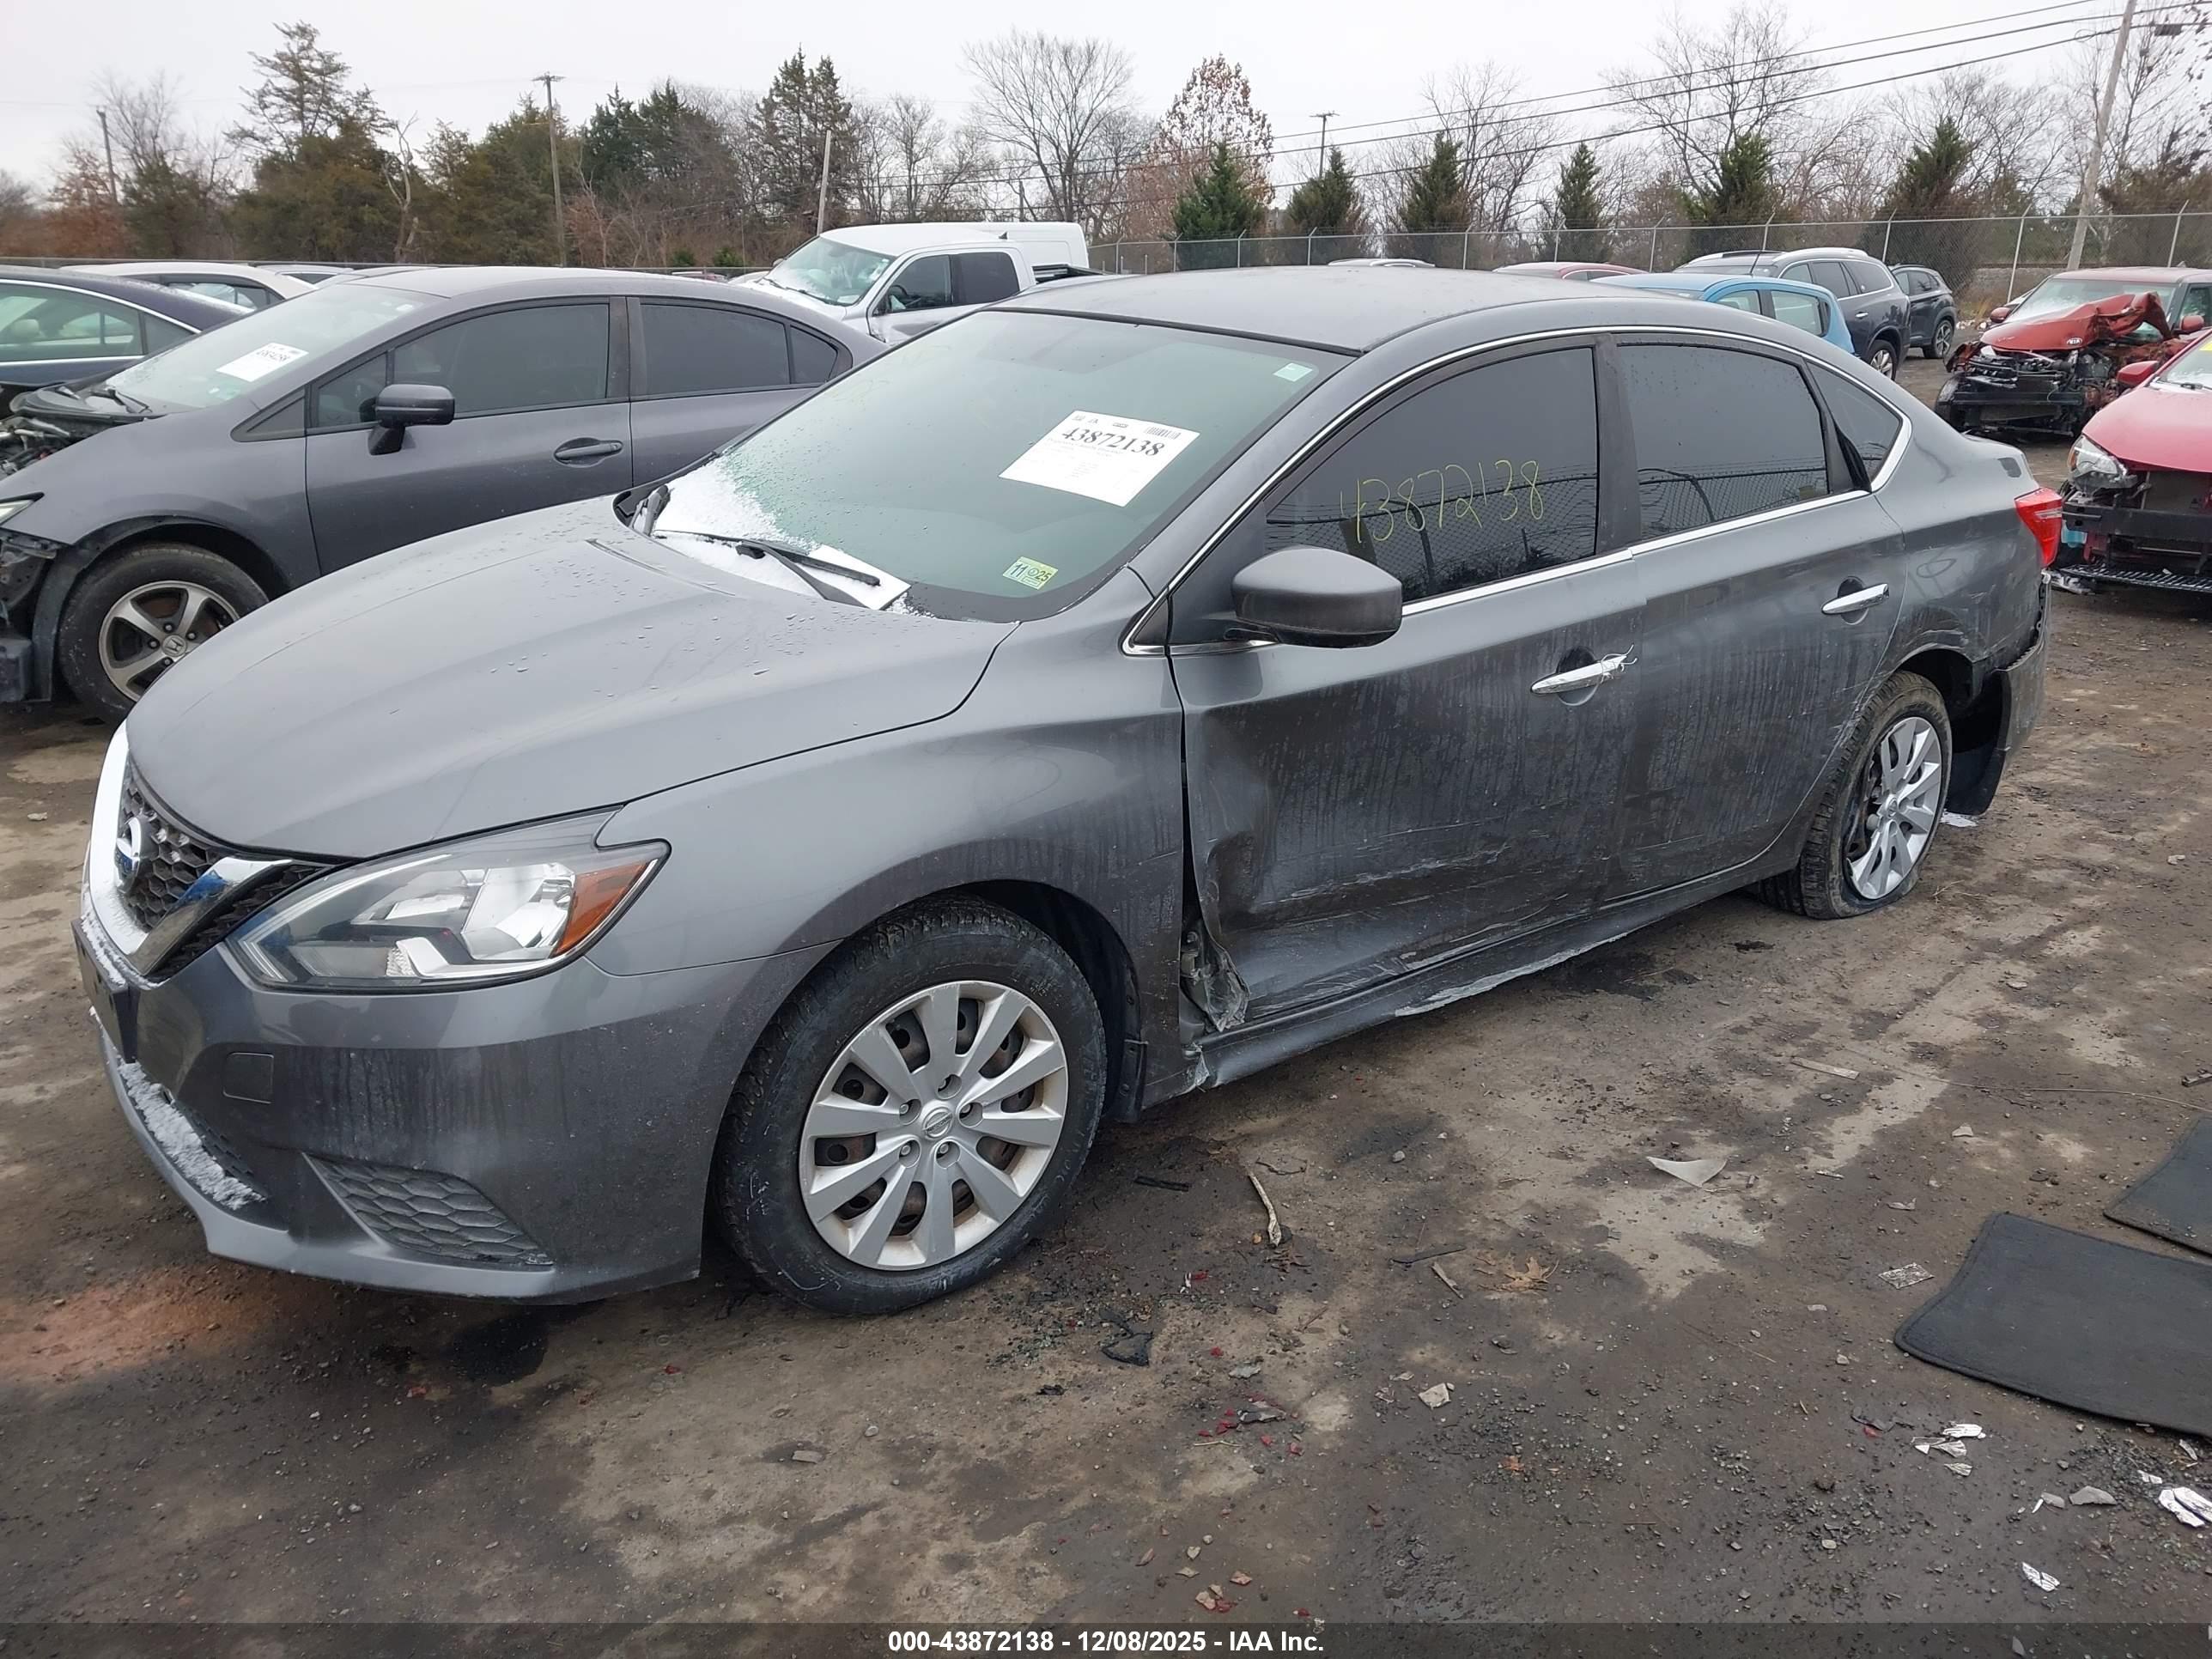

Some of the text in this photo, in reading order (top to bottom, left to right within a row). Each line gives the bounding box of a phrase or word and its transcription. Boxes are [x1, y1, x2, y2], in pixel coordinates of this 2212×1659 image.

[1061, 427, 1165, 457] 43872138
[1339, 459, 1544, 544] 43872138
[1010, 562, 1029, 578] 11
[1034, 570, 1052, 582] 25
